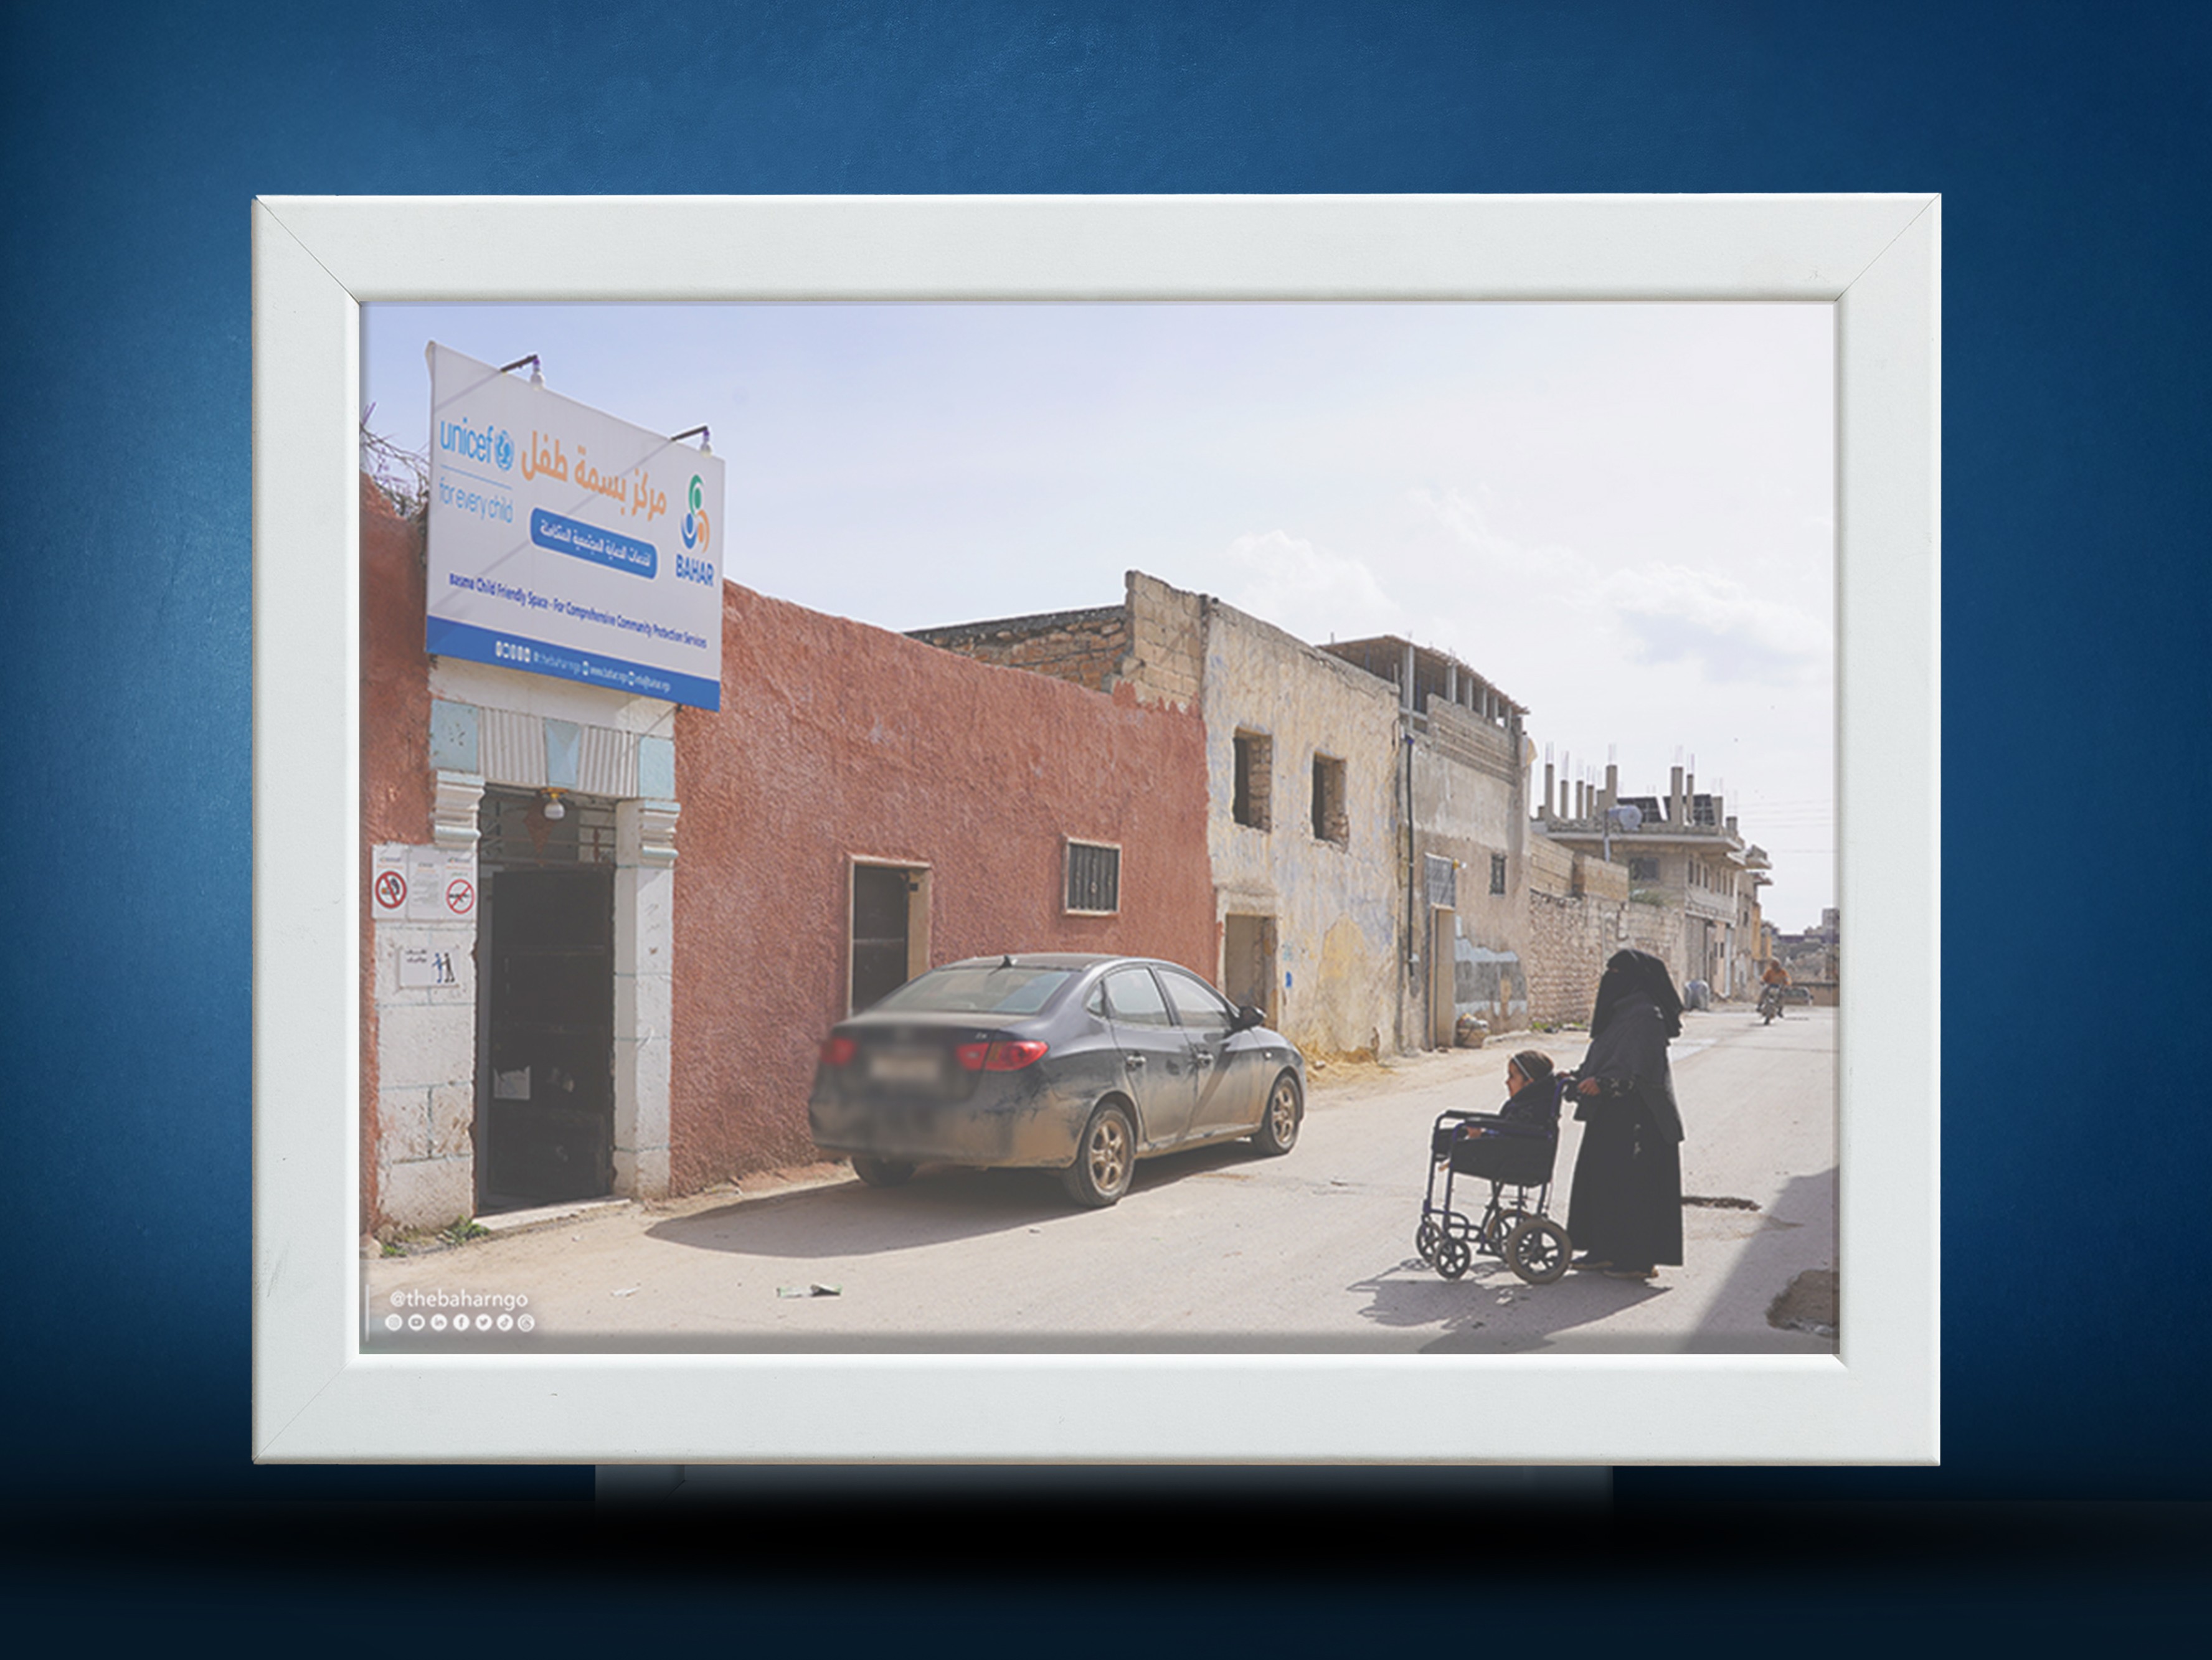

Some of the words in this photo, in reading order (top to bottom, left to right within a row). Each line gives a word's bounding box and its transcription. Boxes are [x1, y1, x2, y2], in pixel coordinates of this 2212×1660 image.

[440, 417, 493, 463] unicef
[521, 431, 567, 482] طفل
[439, 476, 455, 505] for
[456, 489, 487, 520] every
[488, 494, 514, 523] child
[574, 445, 626, 516] بسمة
[631, 468, 666, 521] مركز
[676, 554, 714, 587] BAHAR
[476, 577, 496, 595] Child
[498, 583, 526, 606] Friendly
[528, 591, 549, 610] Space
[554, 598, 565, 613] For
[566, 601, 616, 626] Comprehensive
[617, 614, 652, 638] Community
[653, 623, 683, 643] Protection
[684, 631, 707, 649] Services
